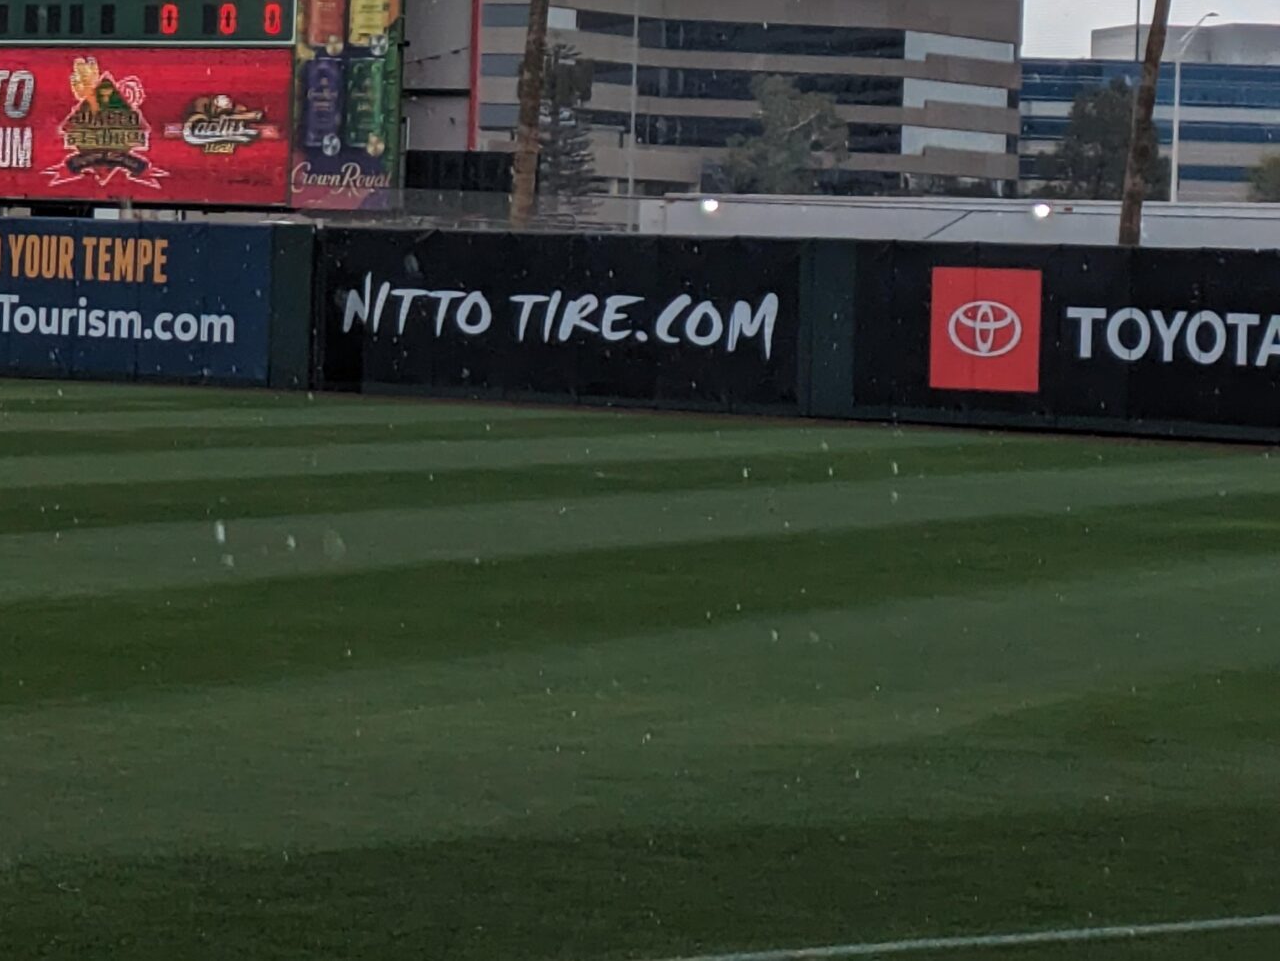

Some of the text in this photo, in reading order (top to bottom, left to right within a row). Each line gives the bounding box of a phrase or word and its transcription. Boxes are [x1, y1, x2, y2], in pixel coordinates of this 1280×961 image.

[161, 3, 178, 35] 0
[219, 3, 237, 35] 0
[264, 3, 281, 35] 0
[291, 162, 392, 197] Crown Royal
[8, 234, 75, 280] YOUR
[82, 237, 169, 284] TEMPE
[342, 271, 779, 361] NITTO TIRE.COM
